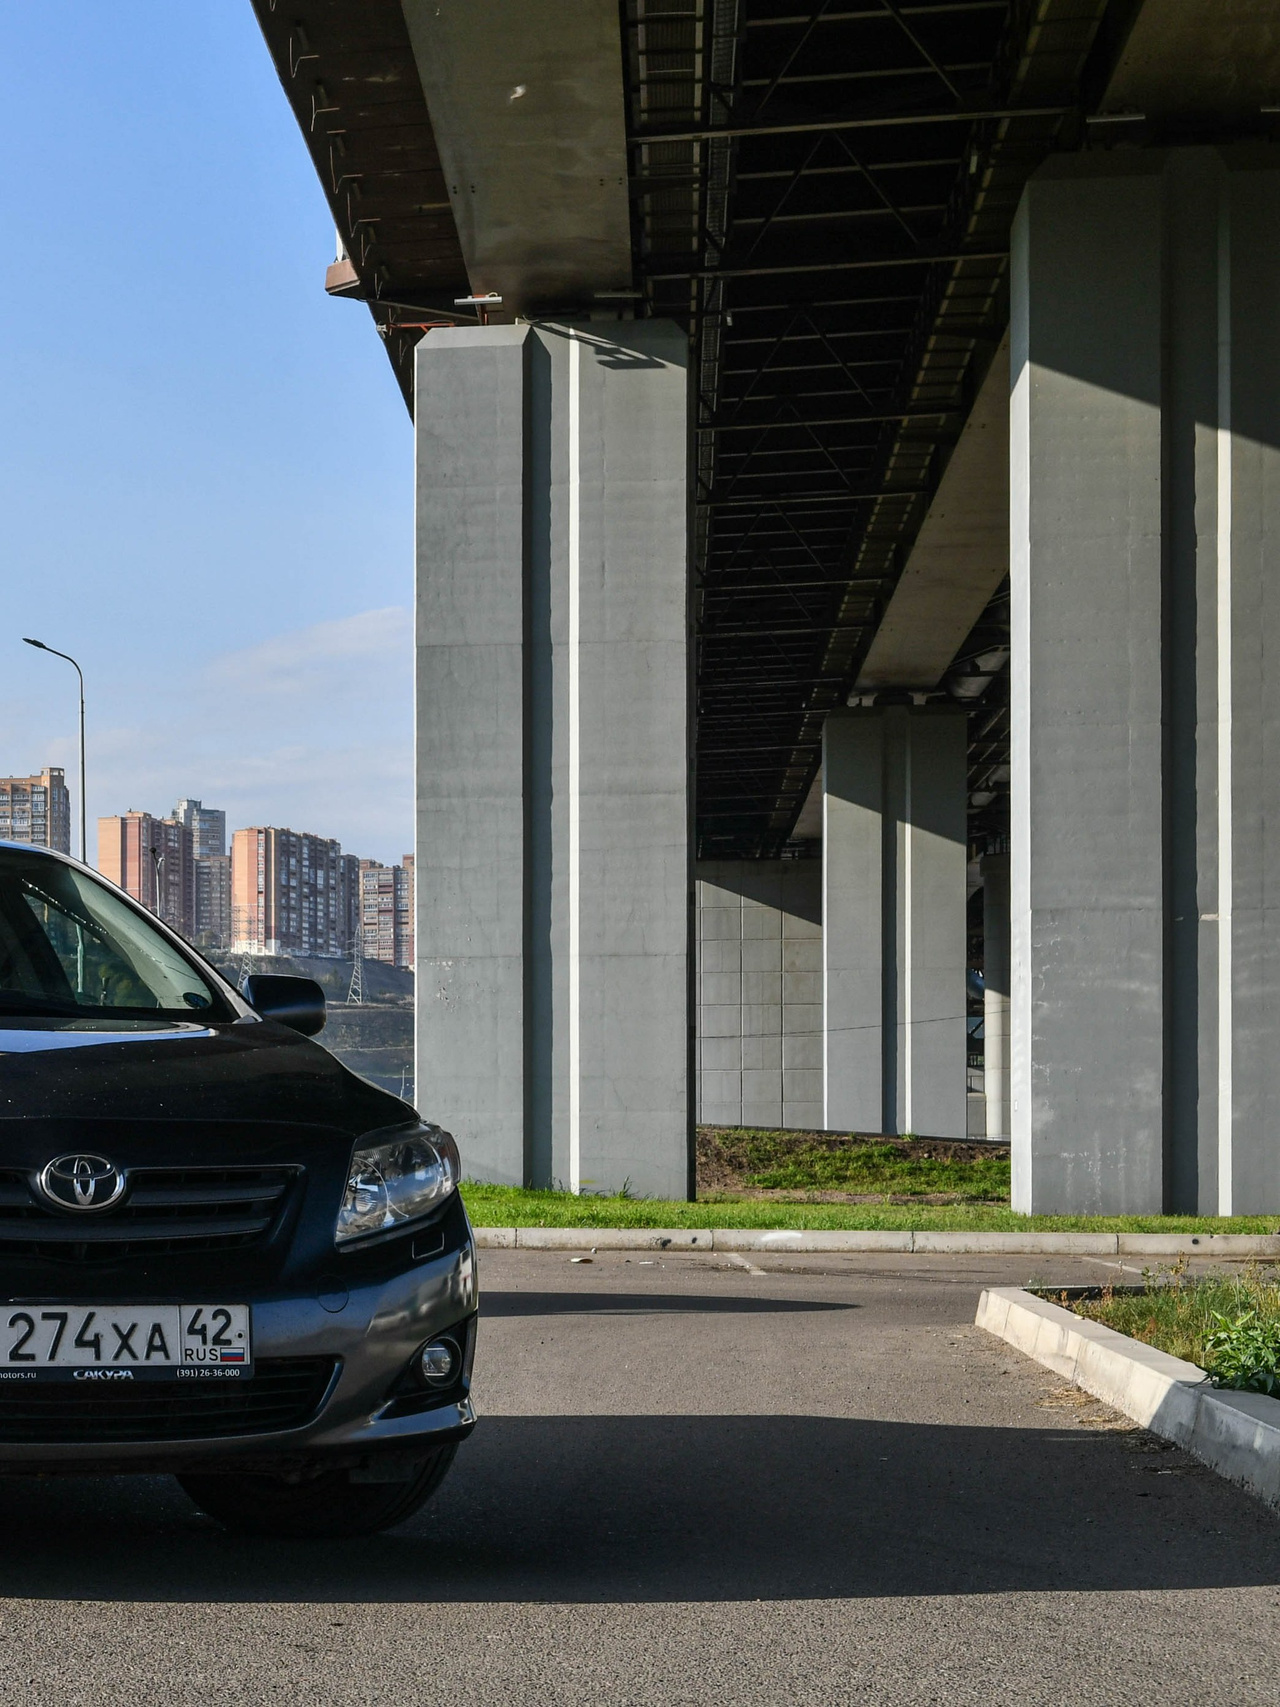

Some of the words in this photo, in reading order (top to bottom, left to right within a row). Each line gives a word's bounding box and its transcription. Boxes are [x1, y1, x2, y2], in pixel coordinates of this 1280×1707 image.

[187, 1308, 233, 1346] 42
[184, 1347, 219, 1362] RUS
[176, 1368, 198, 1378] (391)
[199, 1368, 240, 1377] 26-36-000
